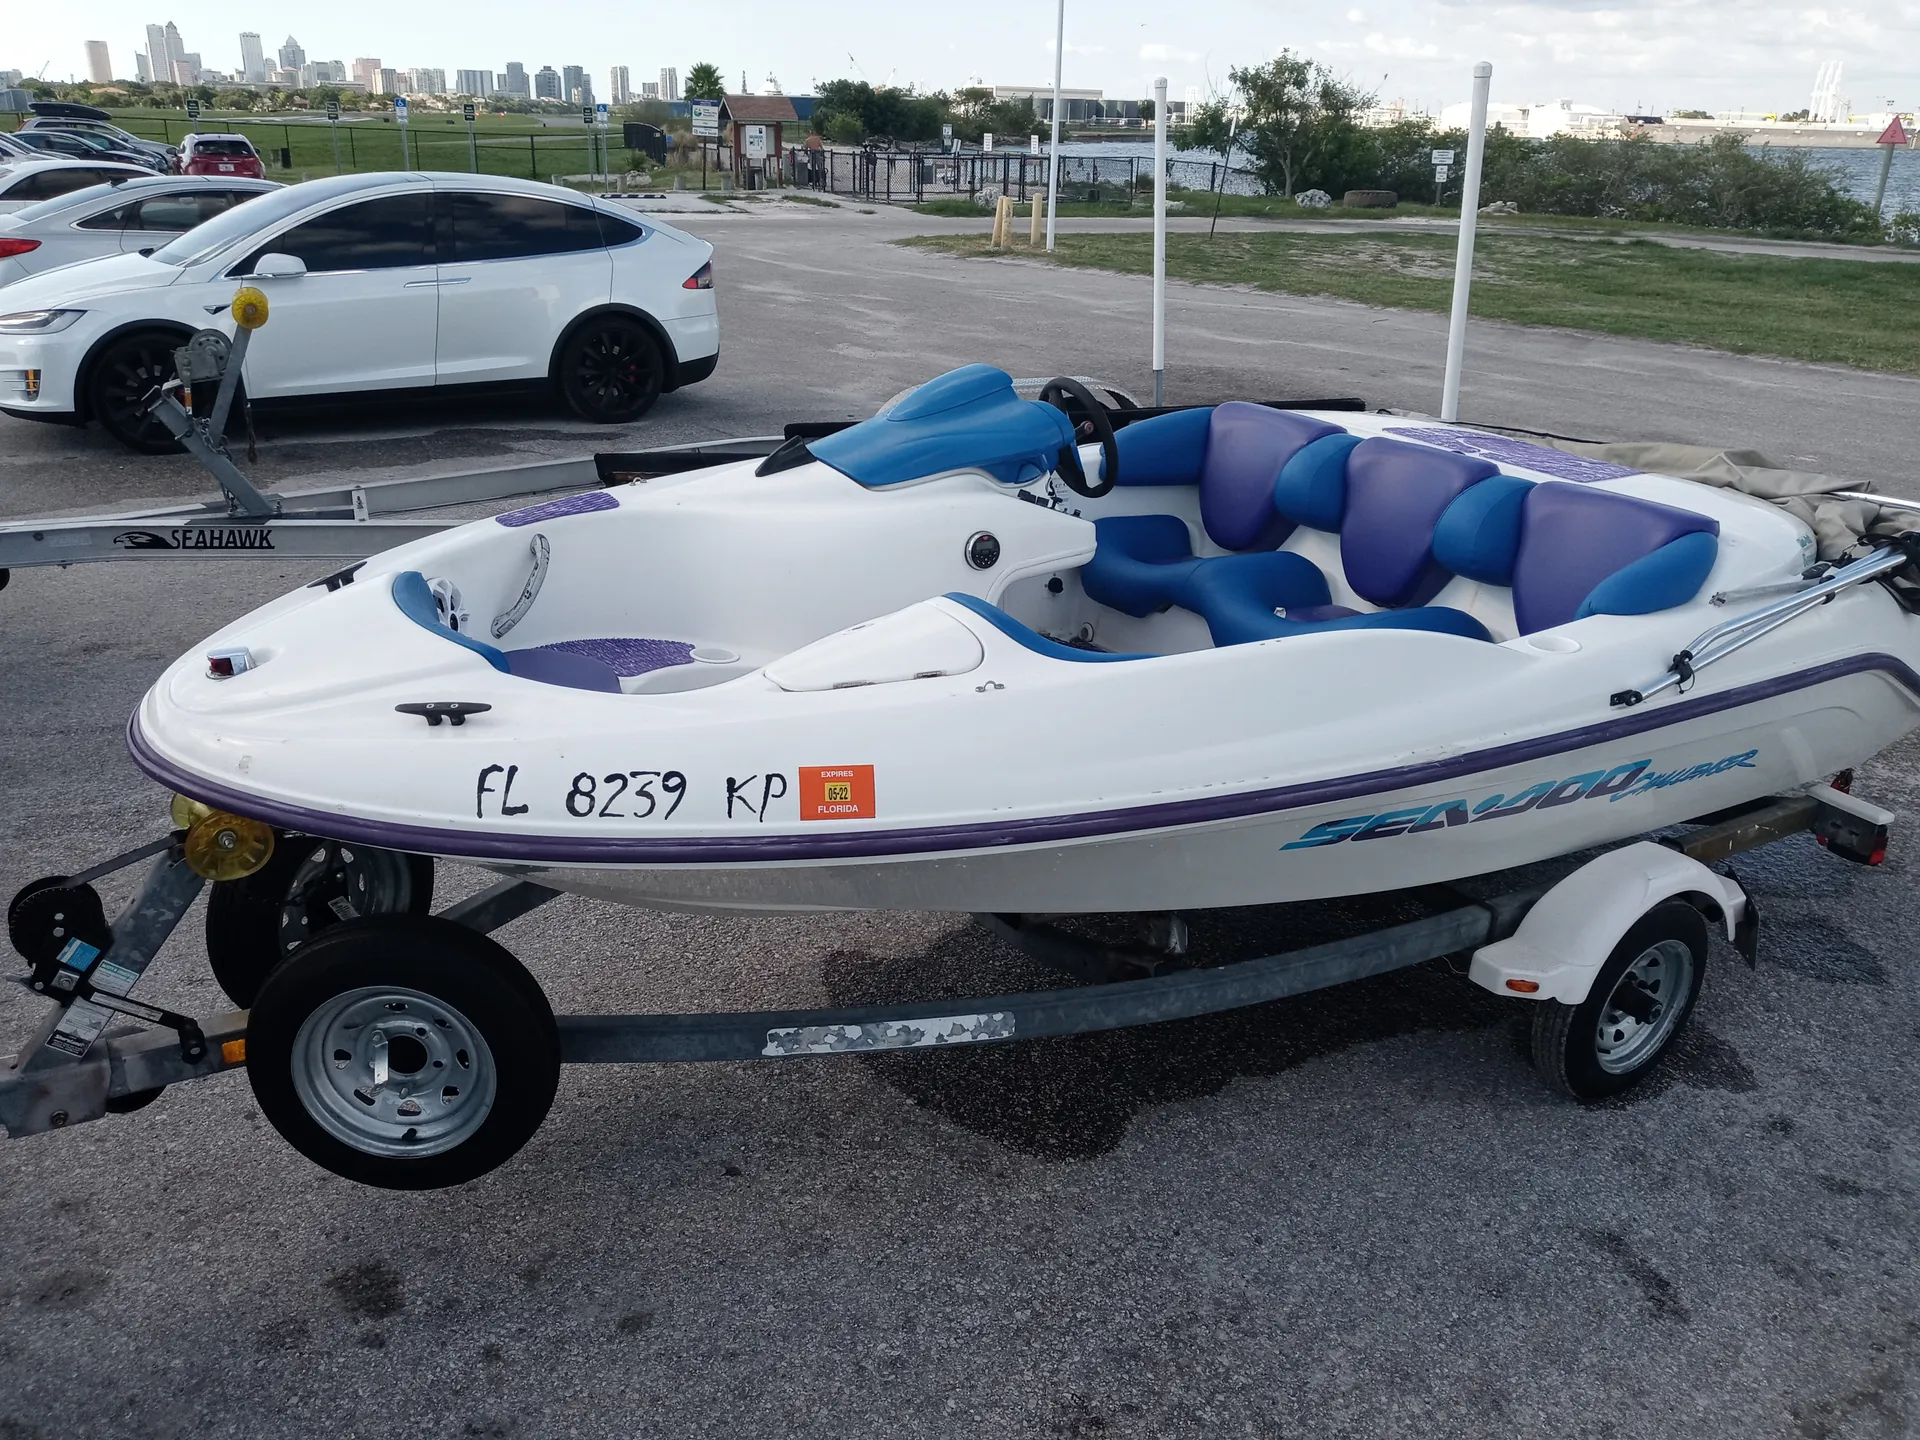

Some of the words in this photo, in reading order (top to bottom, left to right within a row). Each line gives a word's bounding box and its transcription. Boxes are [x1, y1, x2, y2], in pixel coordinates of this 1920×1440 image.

[1890, 129, 1897, 138] 2
[171, 529, 275, 549] SEAHAWK
[821, 770, 854, 778] EXPIRES
[477, 764, 529, 818] FL
[565, 771, 687, 820] 8239
[726, 773, 787, 822] KP
[828, 787, 848, 800] 05-22
[818, 804, 859, 814] FLORIDA
